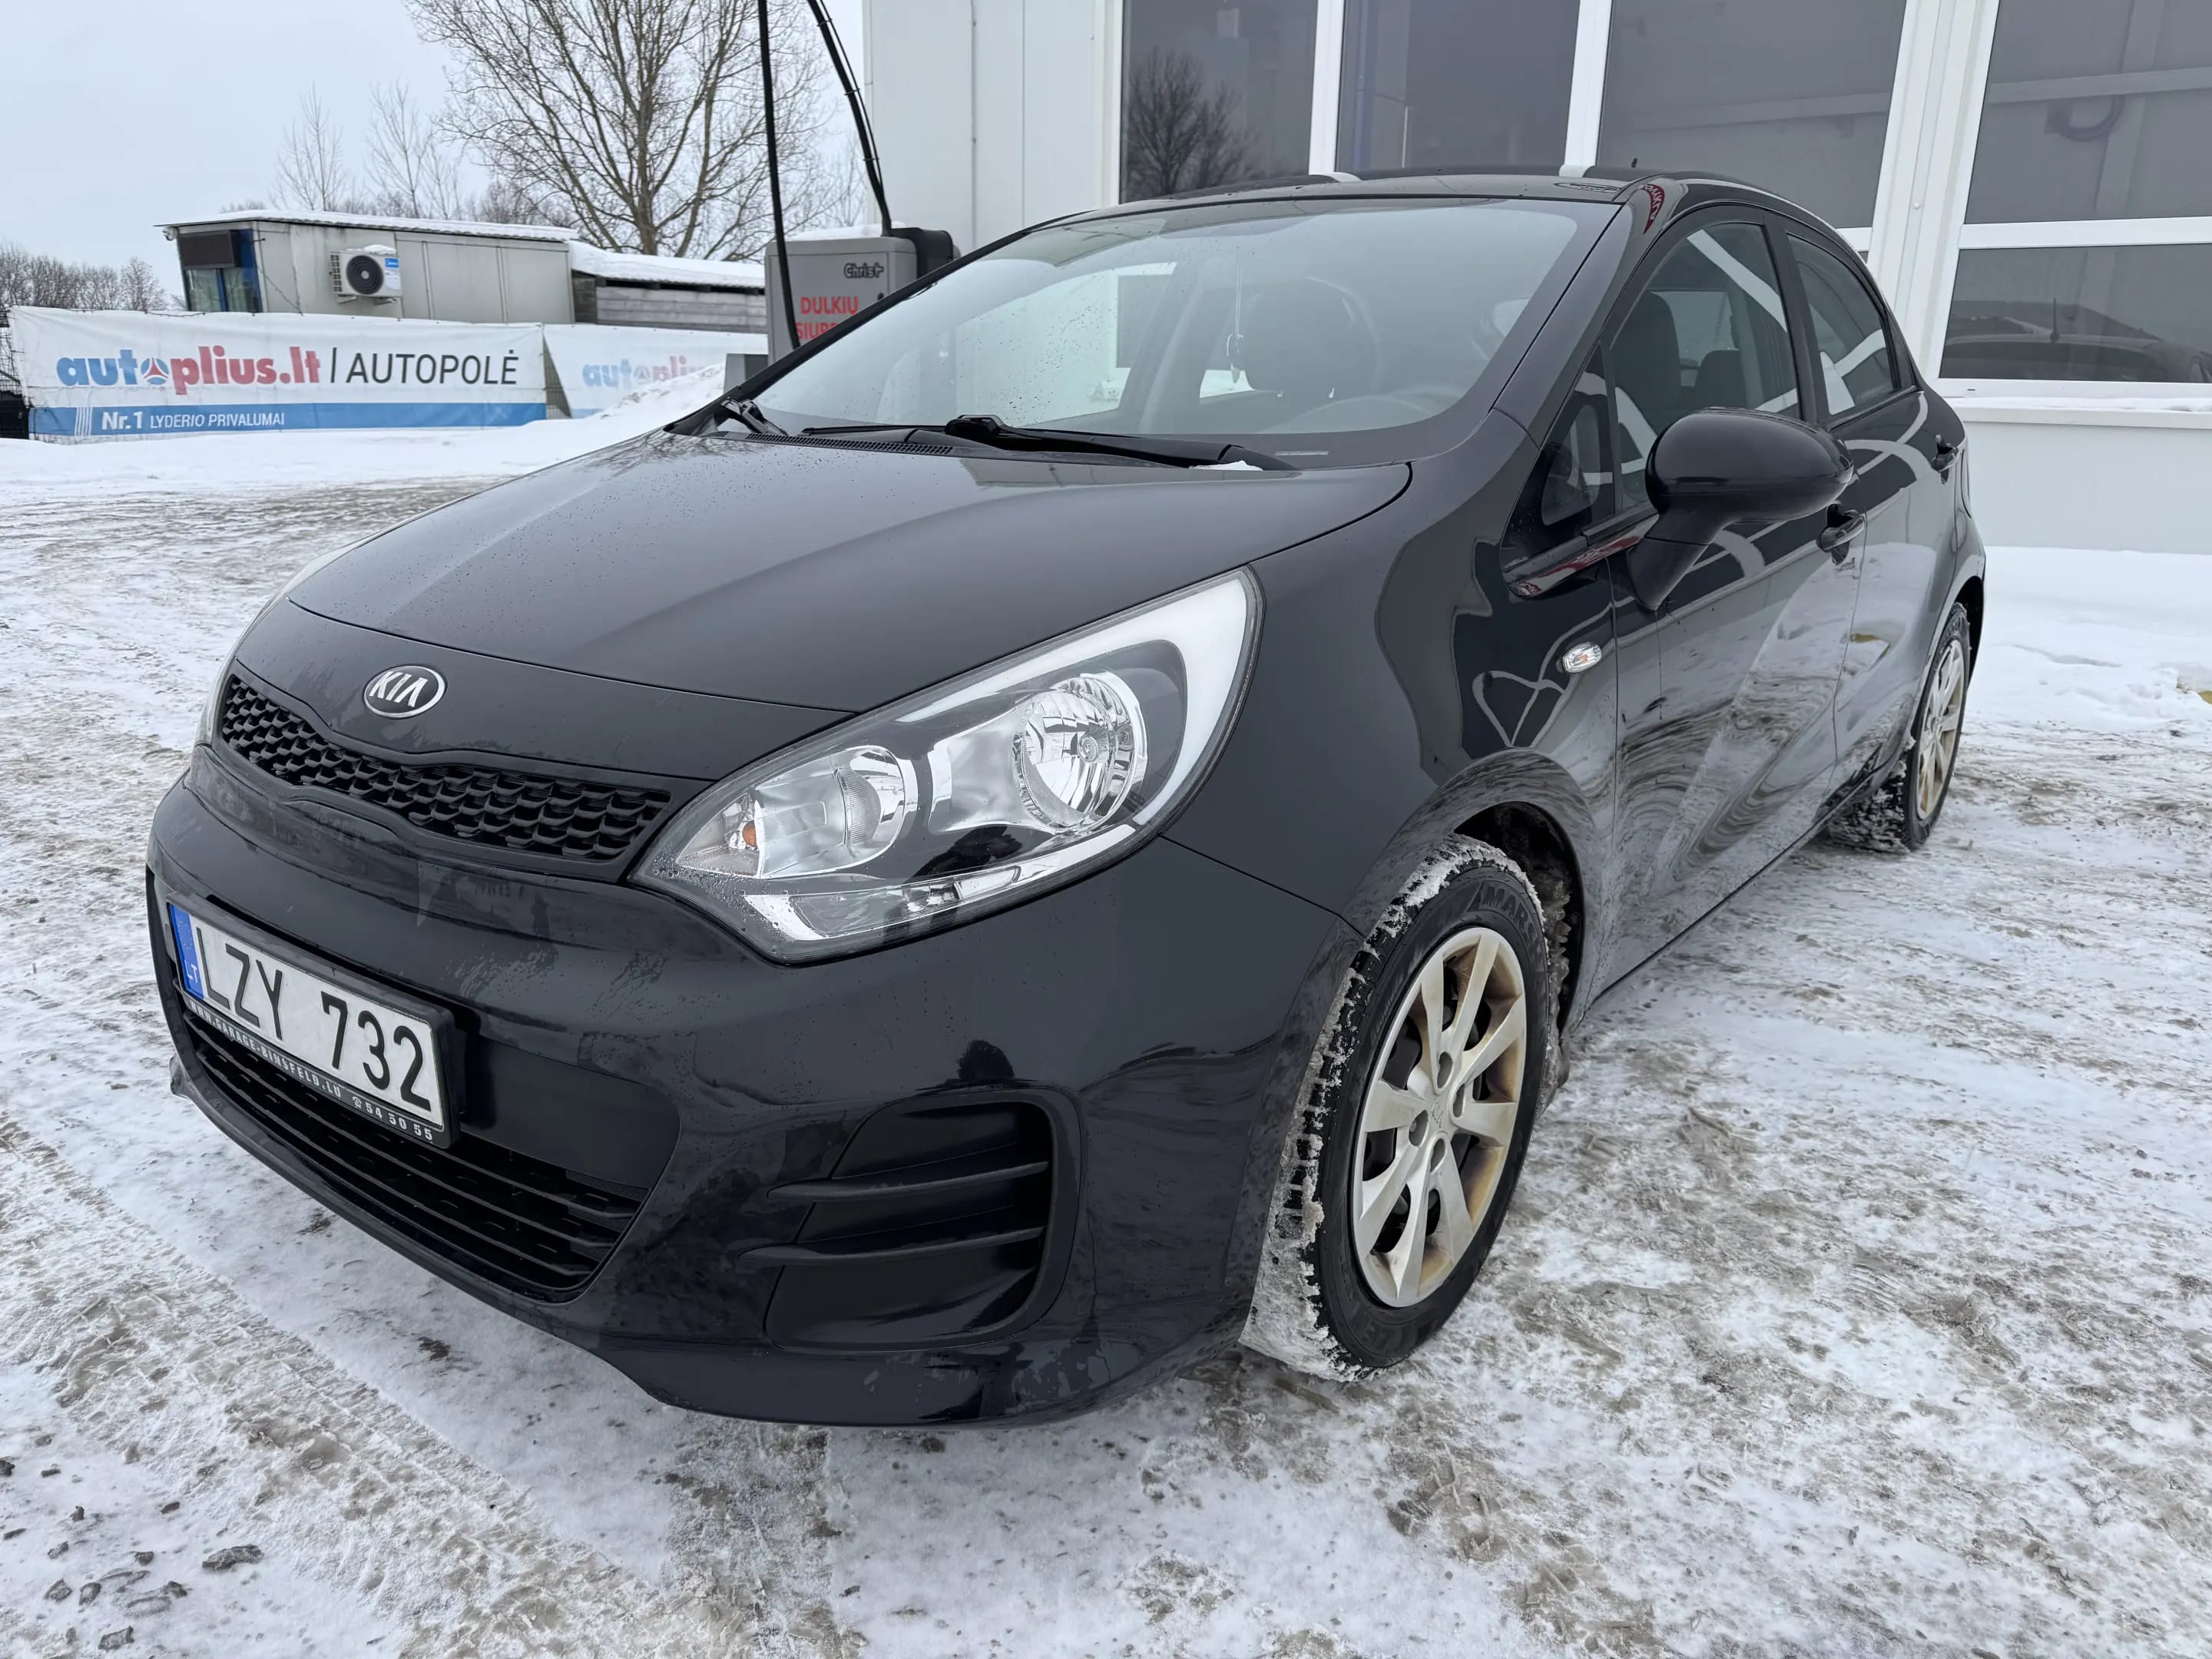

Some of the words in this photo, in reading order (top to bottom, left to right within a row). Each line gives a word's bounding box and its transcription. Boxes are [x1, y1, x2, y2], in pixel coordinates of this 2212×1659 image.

[346, 349, 519, 385] AUTOPOLĖ
[150, 414, 205, 429] LYDERIO
[208, 412, 285, 428] PRIVALUMAI
[369, 671, 429, 707] KIA
[184, 959, 197, 983] LT
[196, 926, 283, 1041] LZY
[320, 990, 432, 1112] 732
[365, 1101, 382, 1119] 54
[388, 1113, 407, 1130] 50
[413, 1124, 433, 1141] 55
